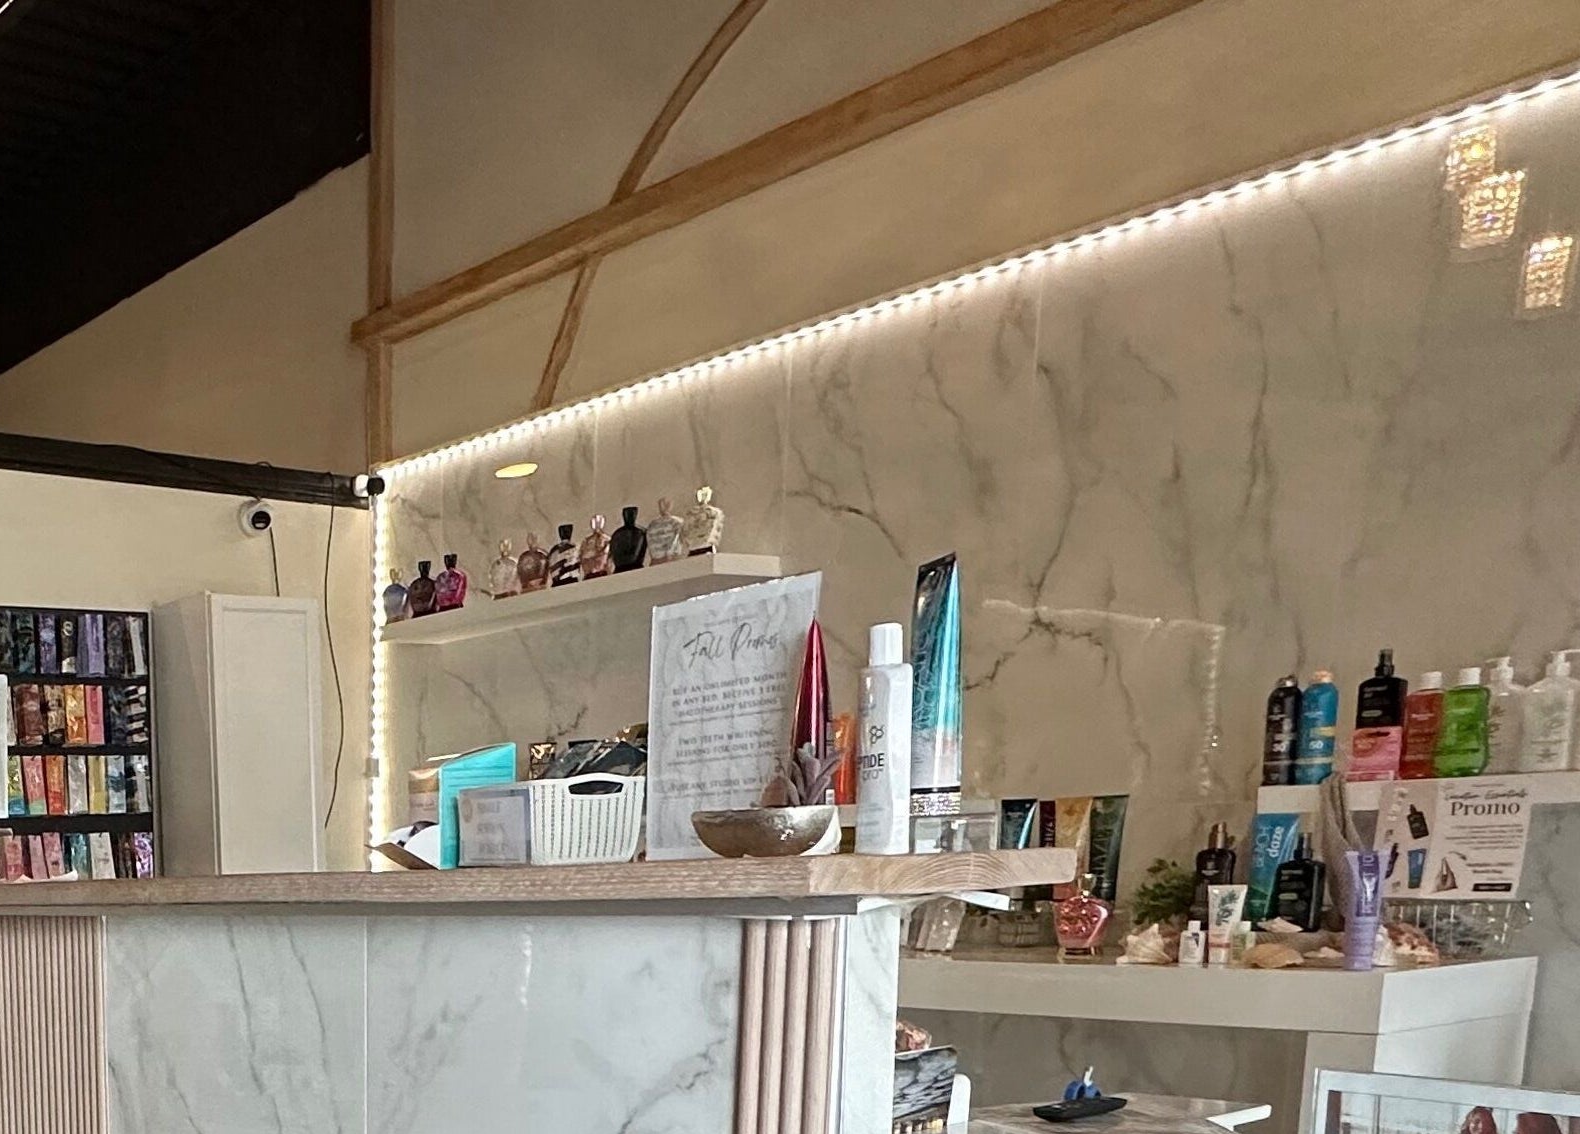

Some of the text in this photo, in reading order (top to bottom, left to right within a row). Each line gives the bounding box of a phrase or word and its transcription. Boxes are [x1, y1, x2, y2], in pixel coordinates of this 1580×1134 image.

[683, 630, 724, 668] Fall
[1450, 801, 1521, 816] Promo
[1268, 825, 1286, 858] daze
